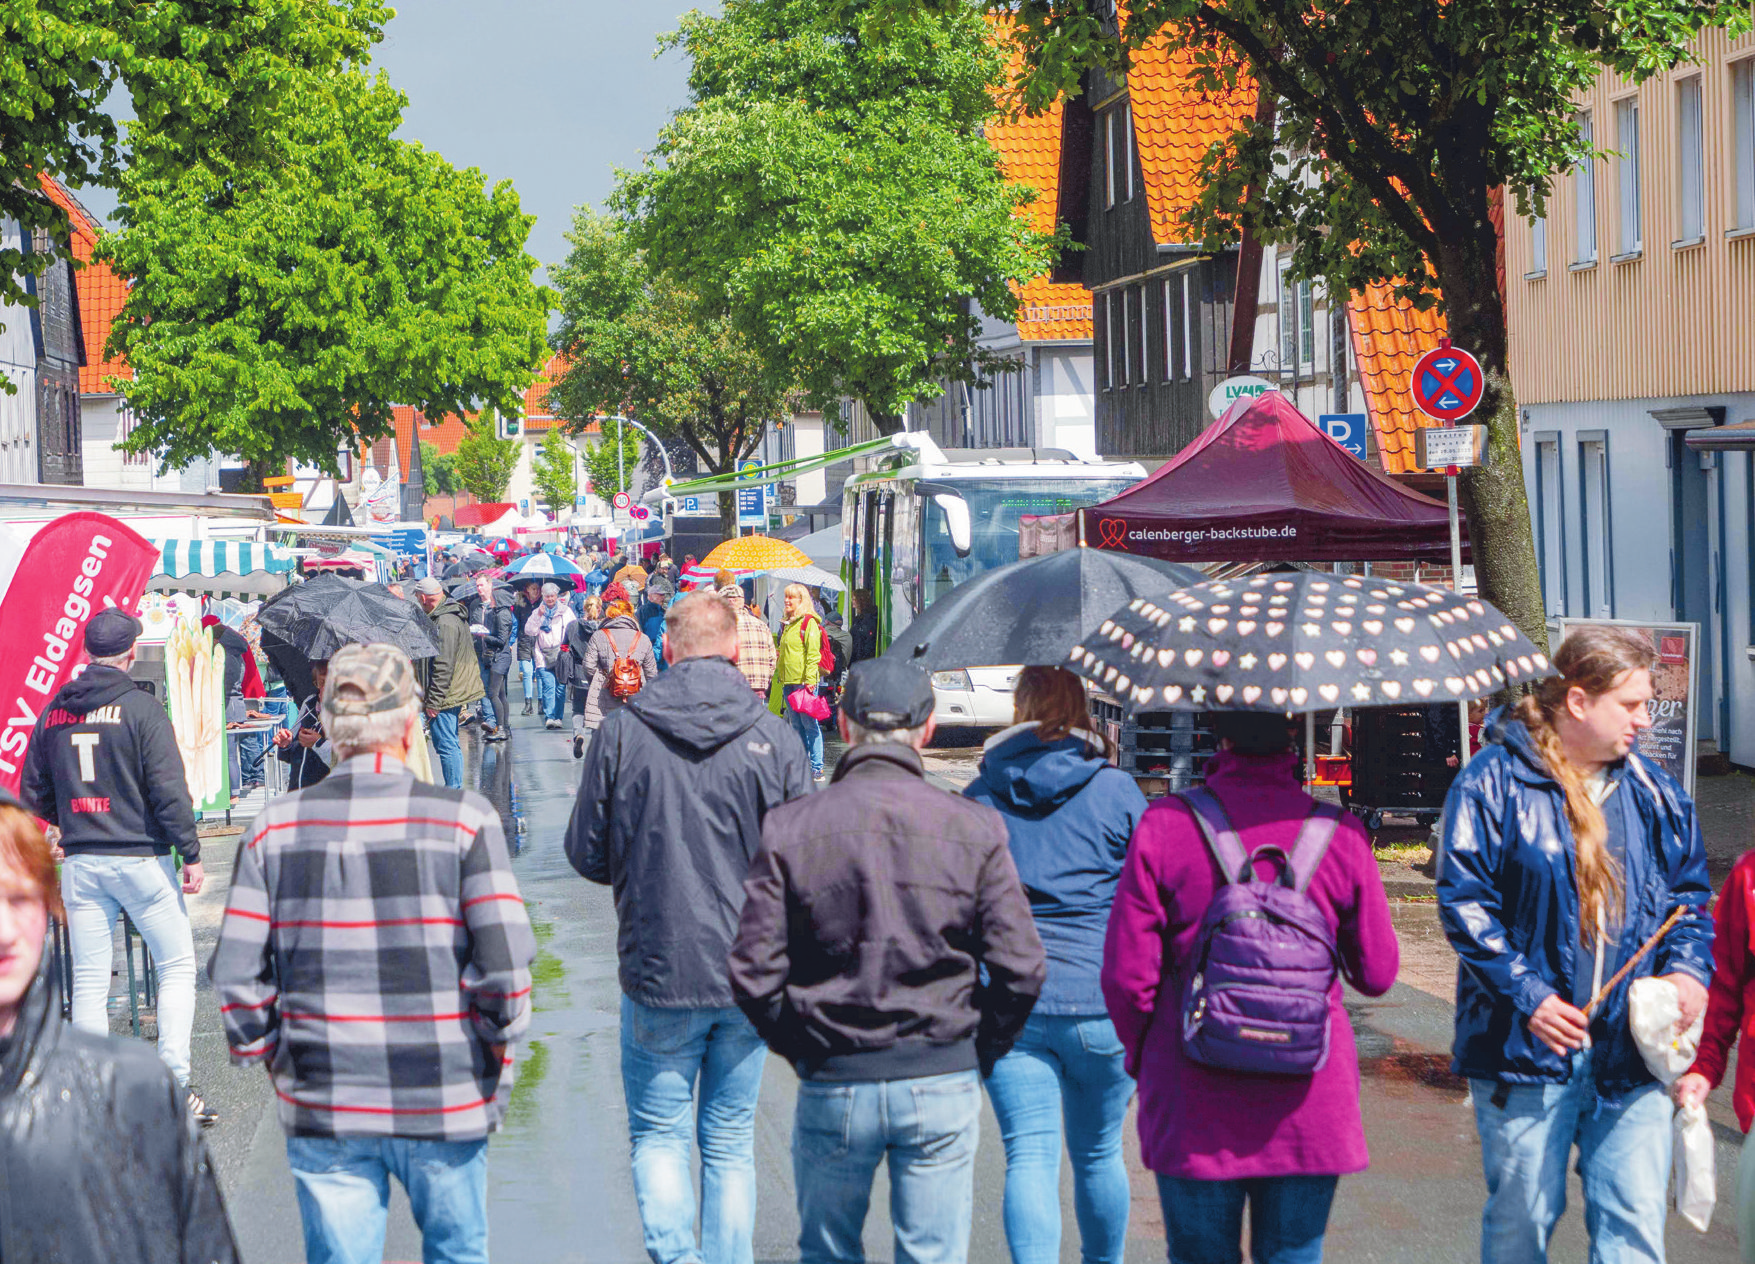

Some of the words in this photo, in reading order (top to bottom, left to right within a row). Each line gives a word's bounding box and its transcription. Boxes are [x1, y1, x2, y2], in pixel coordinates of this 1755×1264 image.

[617, 496, 627, 505] 30
[687, 498, 695, 510] P
[1128, 525, 1297, 543] calenberger-backstube.de
[24, 534, 112, 695] Eldagsen
[71, 732, 100, 782] T
[71, 797, 110, 813] BUNTE
